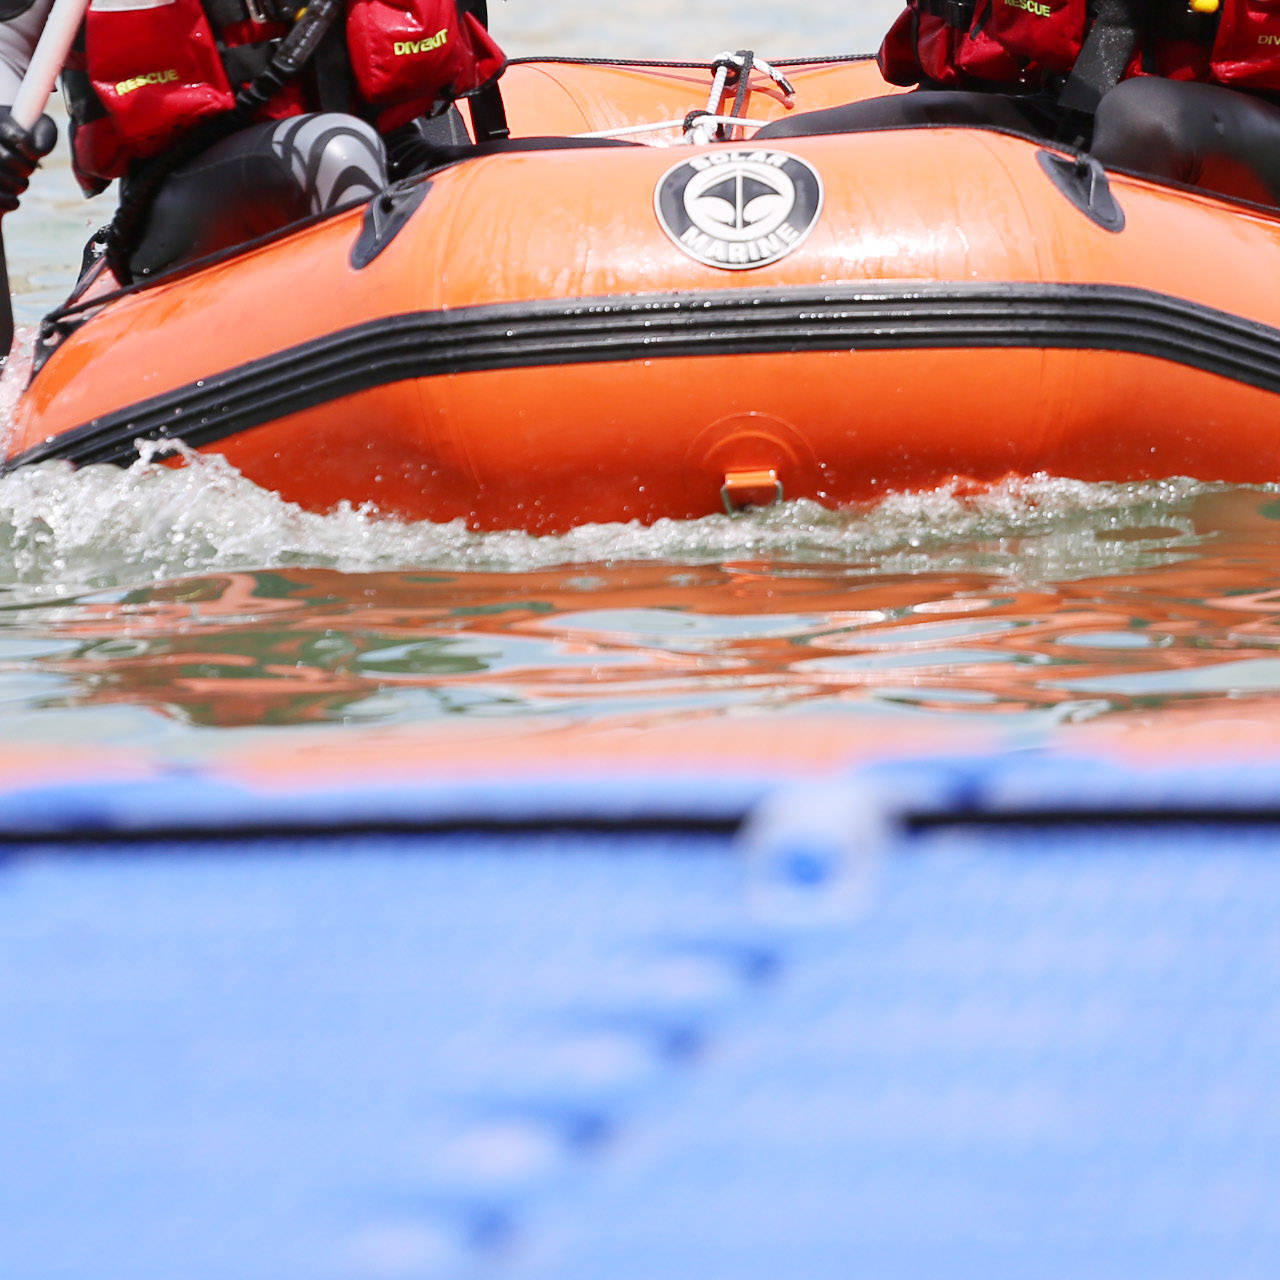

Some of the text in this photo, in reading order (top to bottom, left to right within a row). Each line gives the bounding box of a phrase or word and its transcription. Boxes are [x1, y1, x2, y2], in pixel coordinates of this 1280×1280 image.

[115, 69, 179, 96] RESCUE
[688, 151, 789, 171] SOLAR
[679, 222, 801, 263] MARINE
